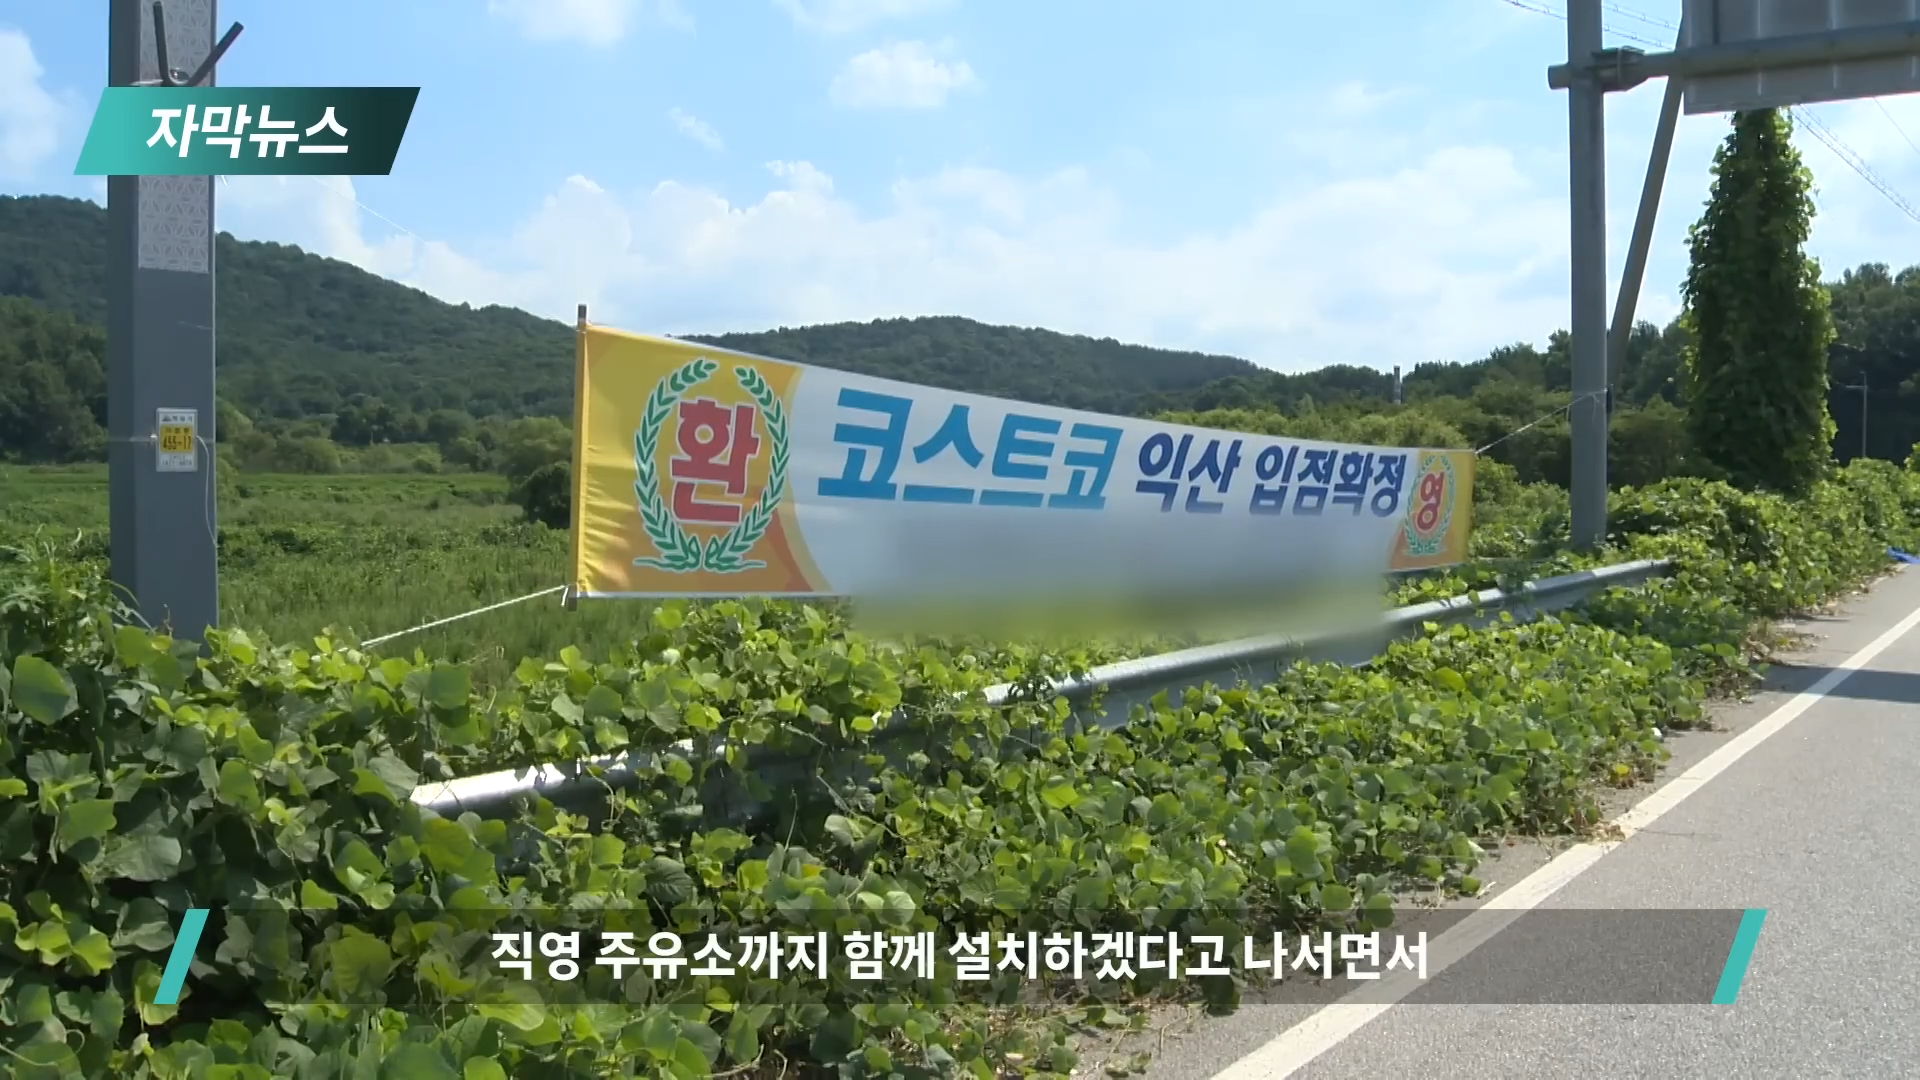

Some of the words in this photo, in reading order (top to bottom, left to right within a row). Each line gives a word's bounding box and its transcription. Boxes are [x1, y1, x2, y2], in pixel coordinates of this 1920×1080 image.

[671, 398, 760, 524] 환
[818, 387, 1123, 510] 코스트코
[1136, 432, 1242, 515] 익산
[1249, 445, 1407, 518] 입점확정
[1416, 471, 1445, 532] 영
